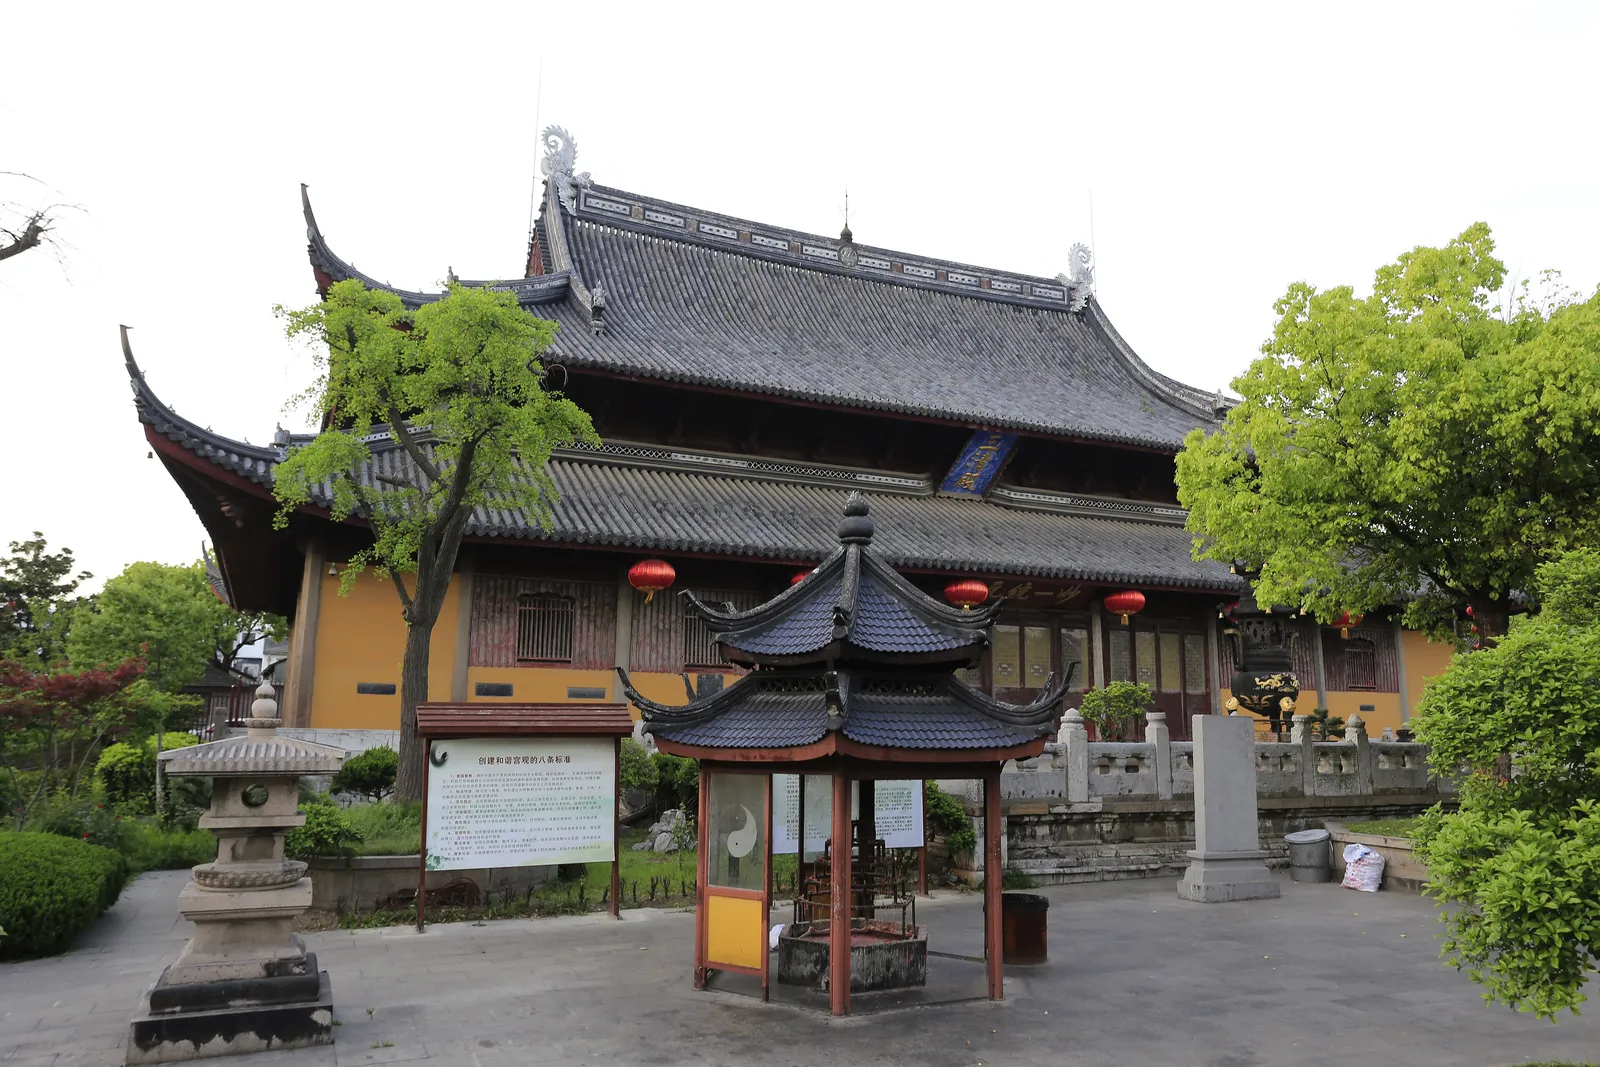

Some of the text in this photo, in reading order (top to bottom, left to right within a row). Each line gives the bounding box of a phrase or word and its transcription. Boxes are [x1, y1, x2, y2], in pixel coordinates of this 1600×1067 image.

[953, 435, 1001, 491] 三清殿
[478, 755, 572, 765] 创建和谐宫观的八条标准
